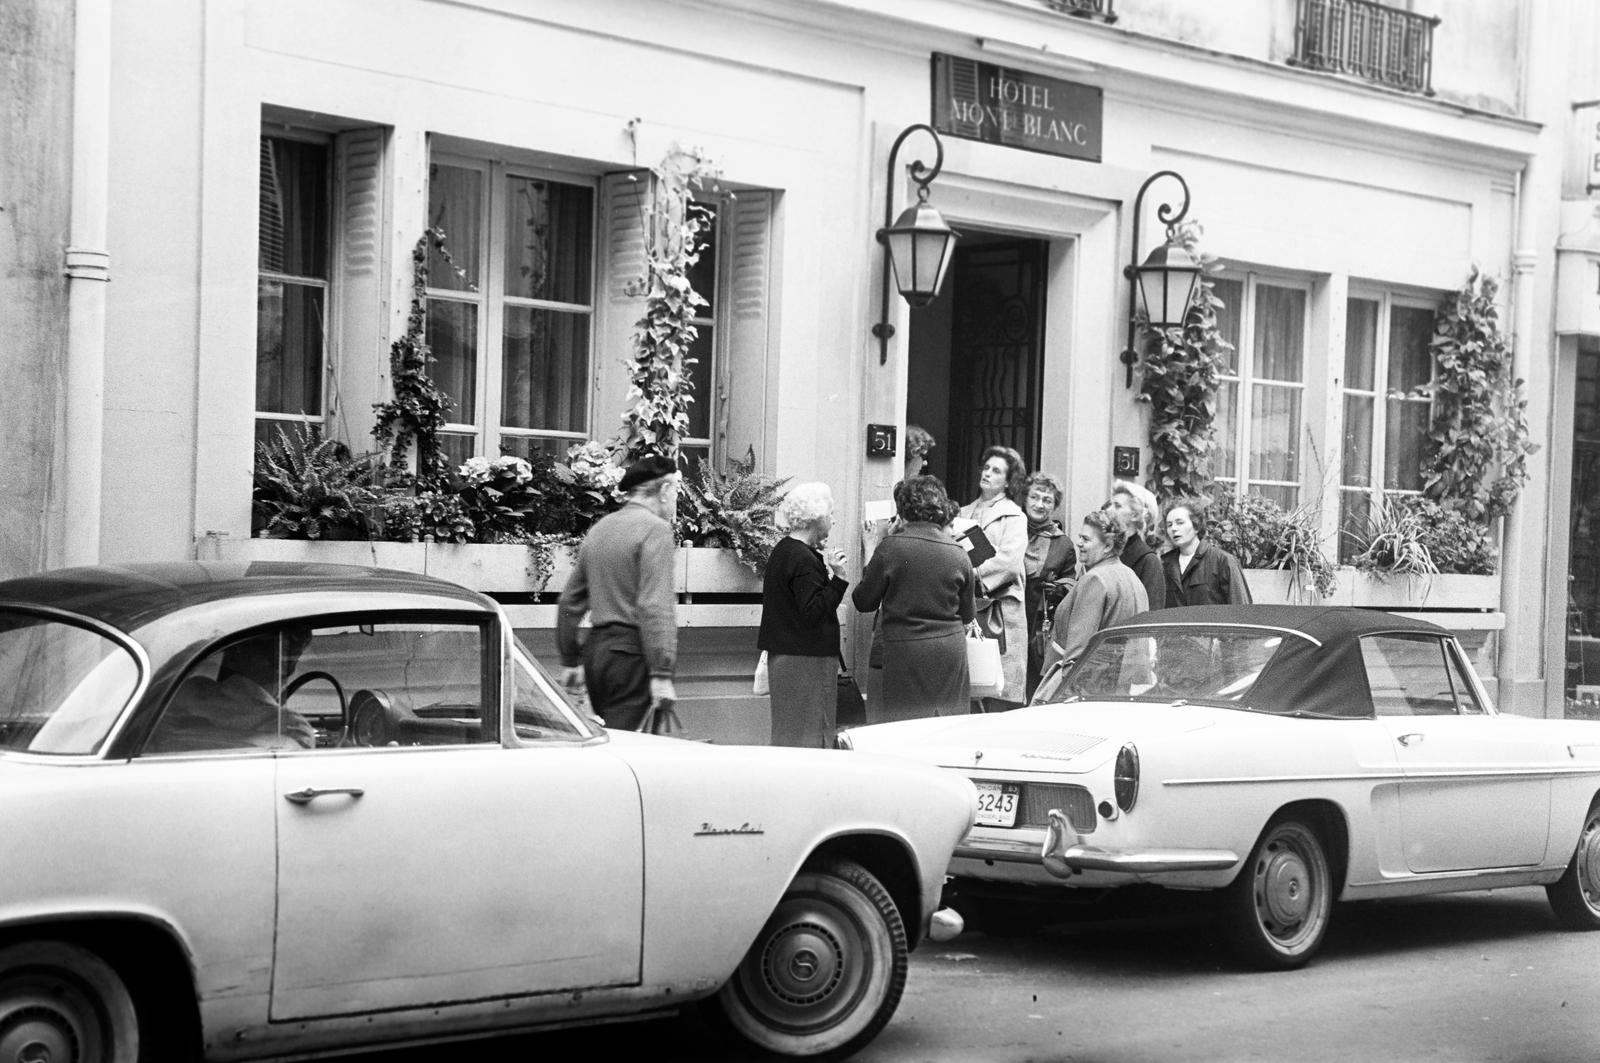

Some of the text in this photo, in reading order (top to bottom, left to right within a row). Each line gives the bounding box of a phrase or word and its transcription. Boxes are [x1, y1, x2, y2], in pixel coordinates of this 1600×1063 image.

[990, 76, 1054, 111] HOTEL
[951, 97, 1087, 146] MONT BLANC
[875, 431, 891, 451] 51
[1120, 453, 1135, 470] 51
